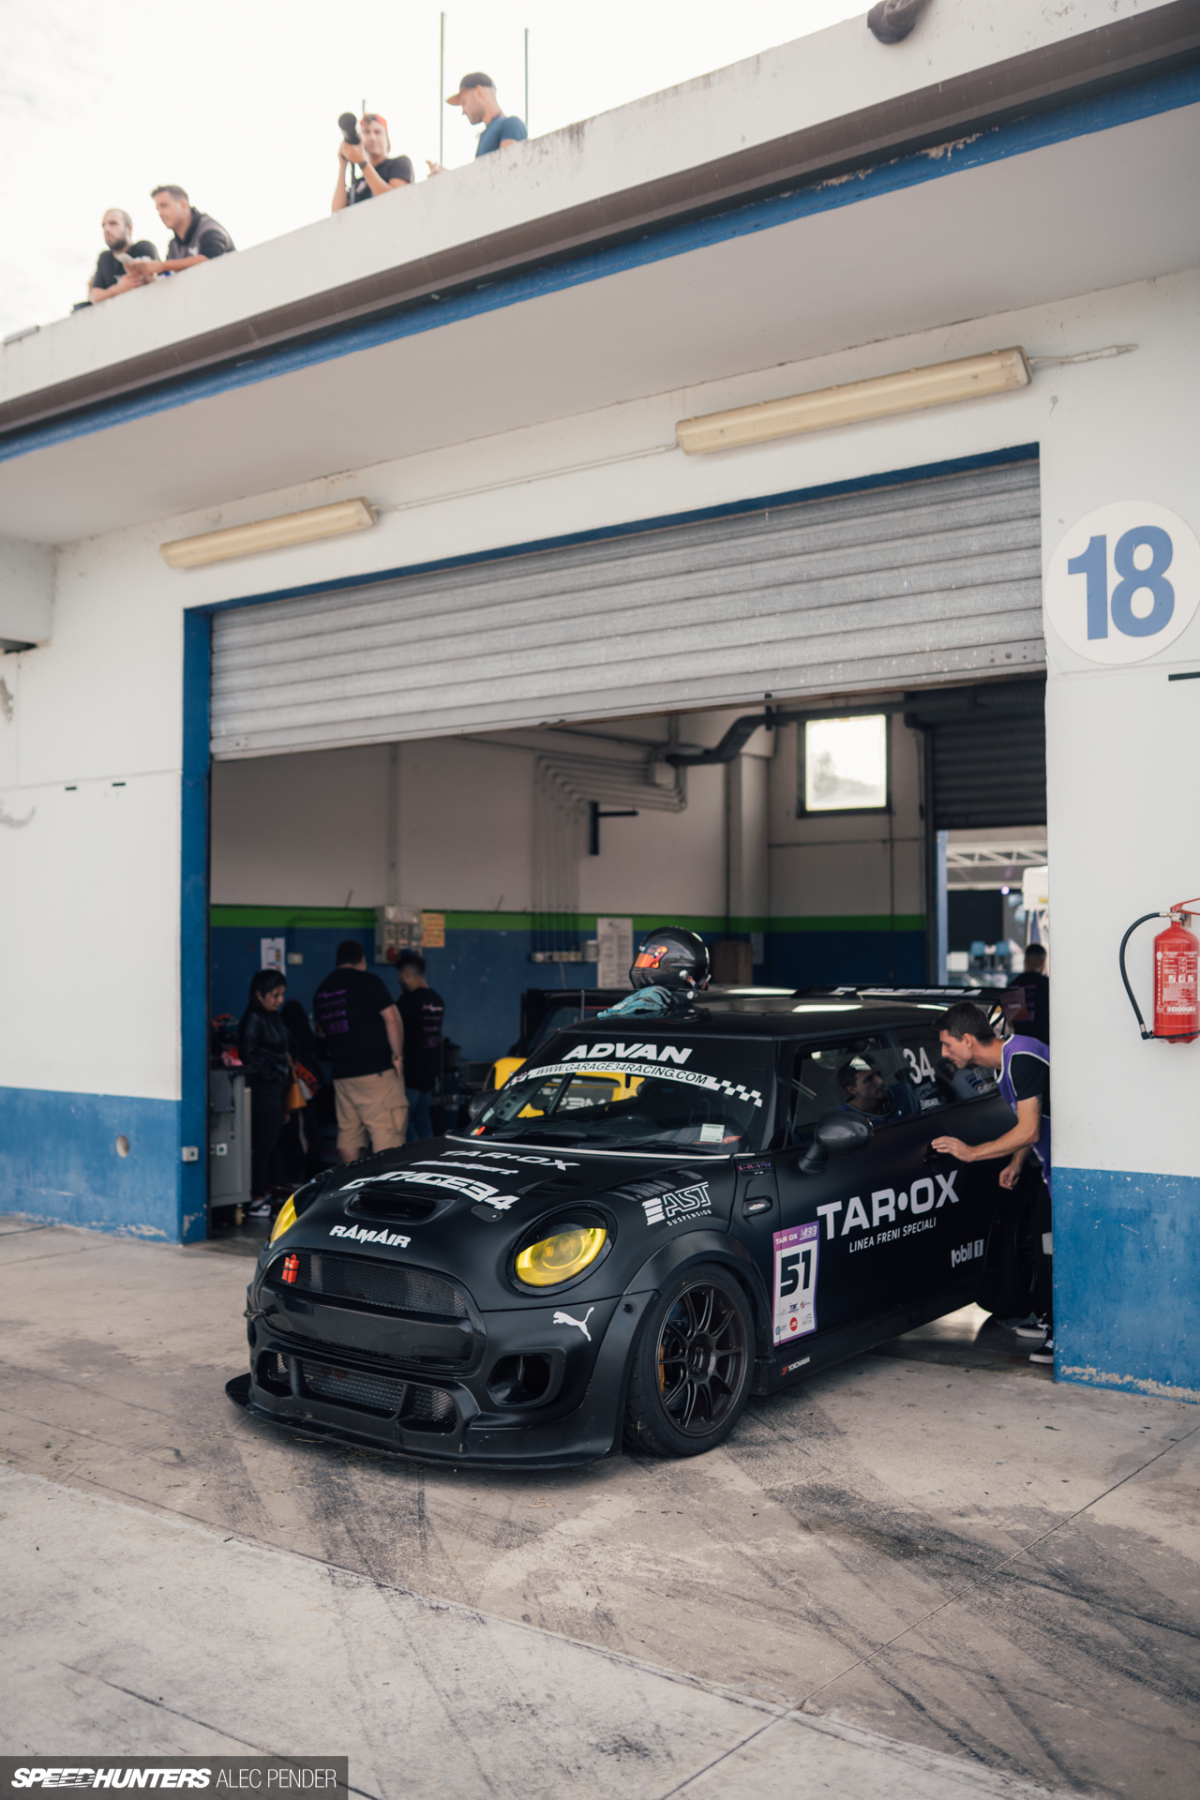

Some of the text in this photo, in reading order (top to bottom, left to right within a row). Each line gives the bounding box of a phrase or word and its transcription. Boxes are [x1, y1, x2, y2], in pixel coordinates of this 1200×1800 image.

[1068, 525, 1175, 640] 18
[561, 1043, 693, 1064] ADVAN
[903, 1047, 936, 1084] 34
[535, 1062, 709, 1085] WWW.GARAGE34RACING.COM
[666, 1209, 712, 1227] SUSPENSION
[329, 1224, 412, 1248] RAMAIR
[849, 1216, 937, 1253] LINEA FRENI SPECIALI
[780, 1249, 812, 1298] 51
